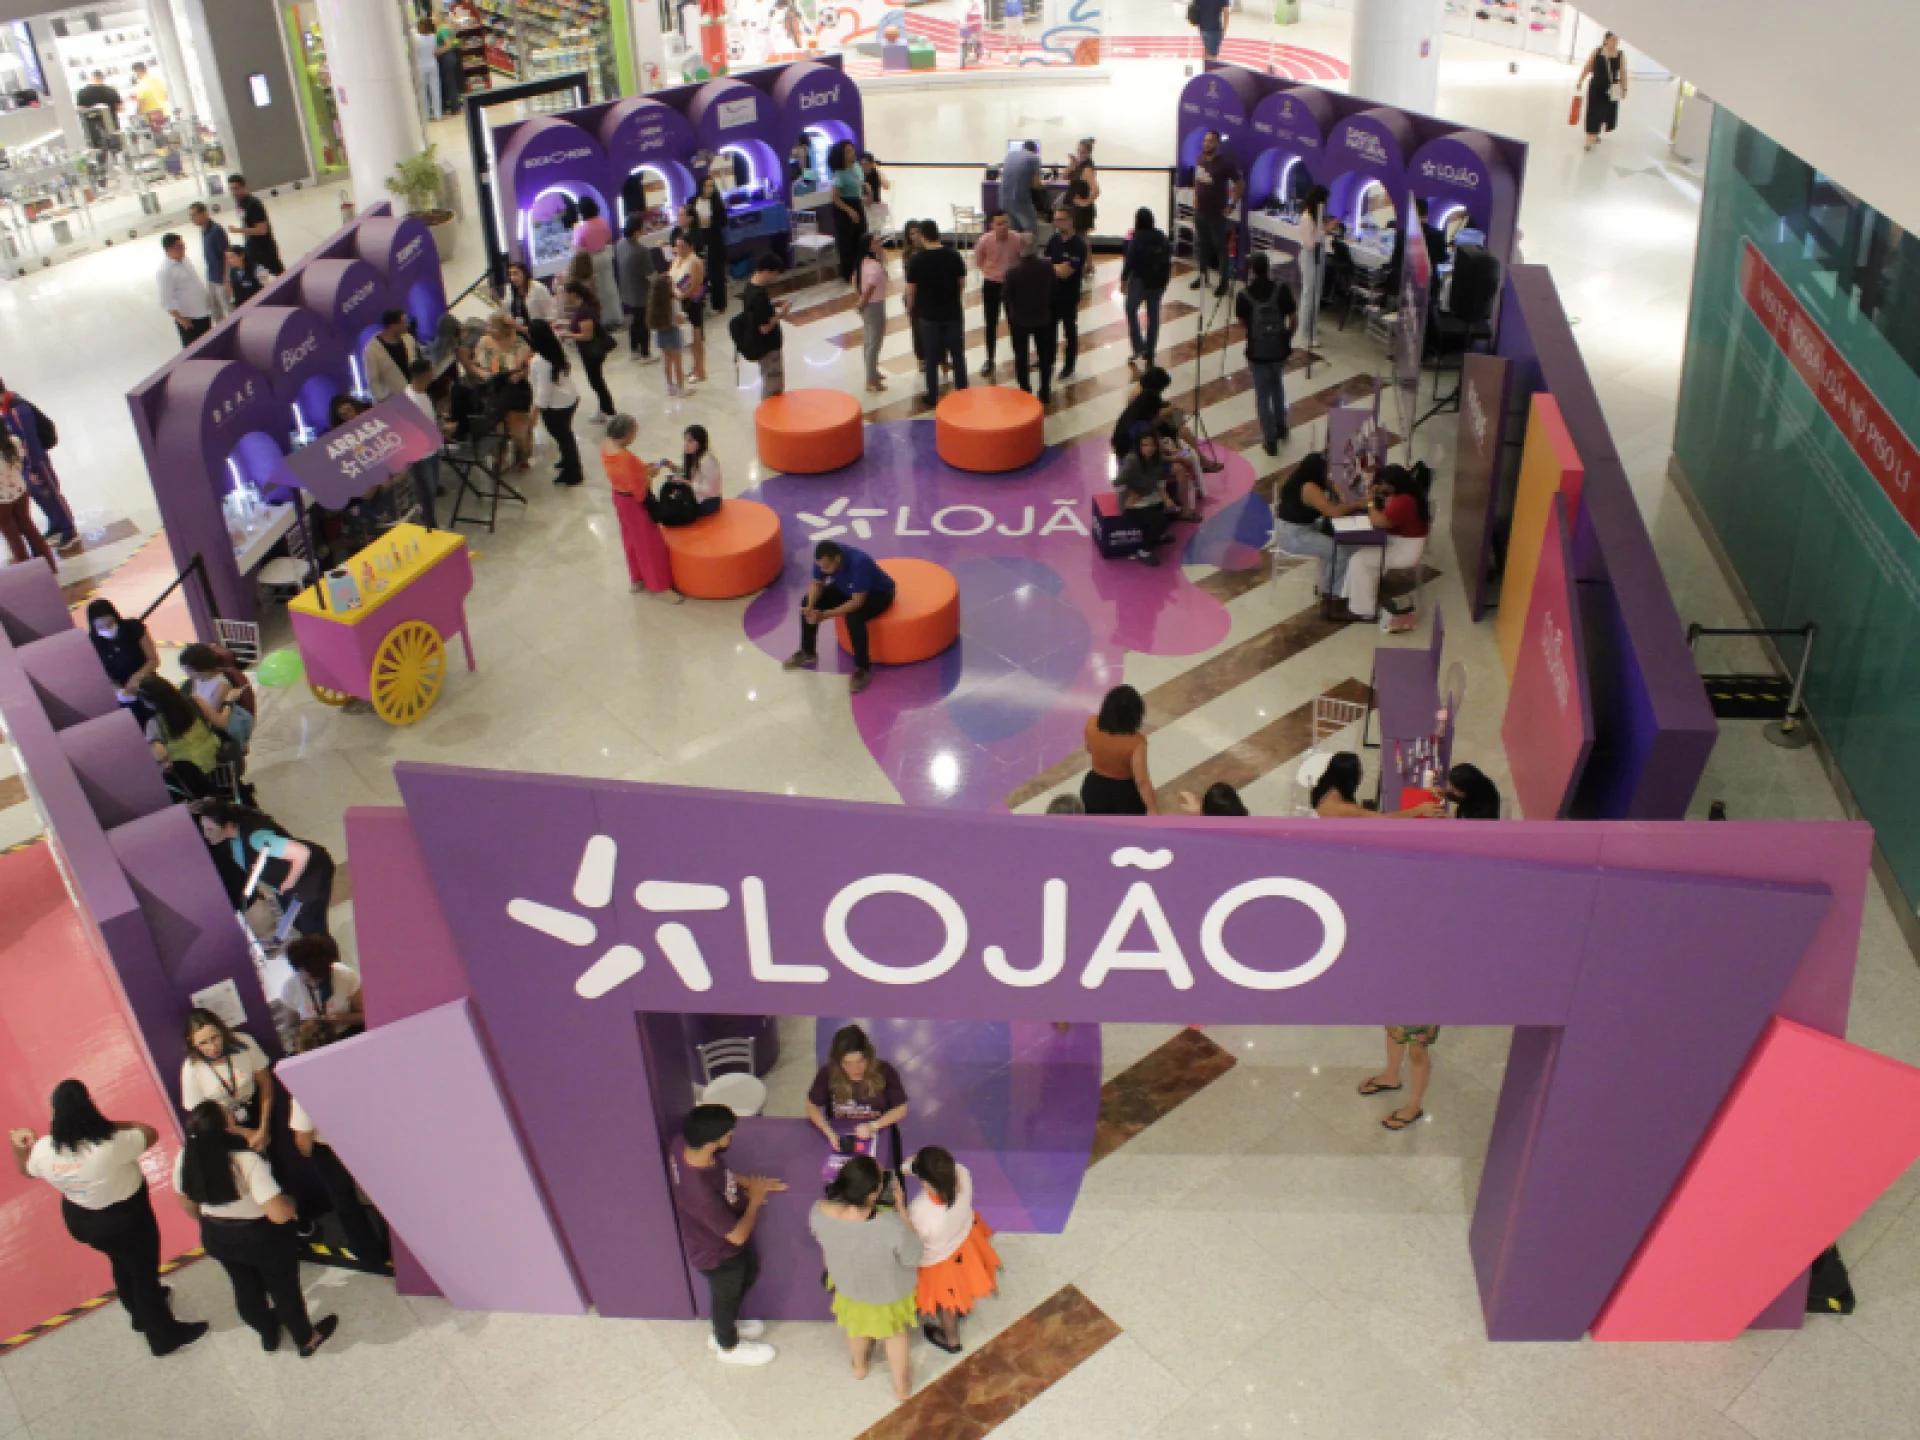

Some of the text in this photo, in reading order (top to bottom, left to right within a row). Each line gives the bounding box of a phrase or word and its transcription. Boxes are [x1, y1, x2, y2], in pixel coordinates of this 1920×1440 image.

[326, 417, 389, 460] ARRASA
[1848, 397, 1867, 433] NO
[1867, 421, 1895, 471] PISO
[894, 499, 1090, 536] LOJÃ
[741, 846, 1347, 990] LOJÃO
